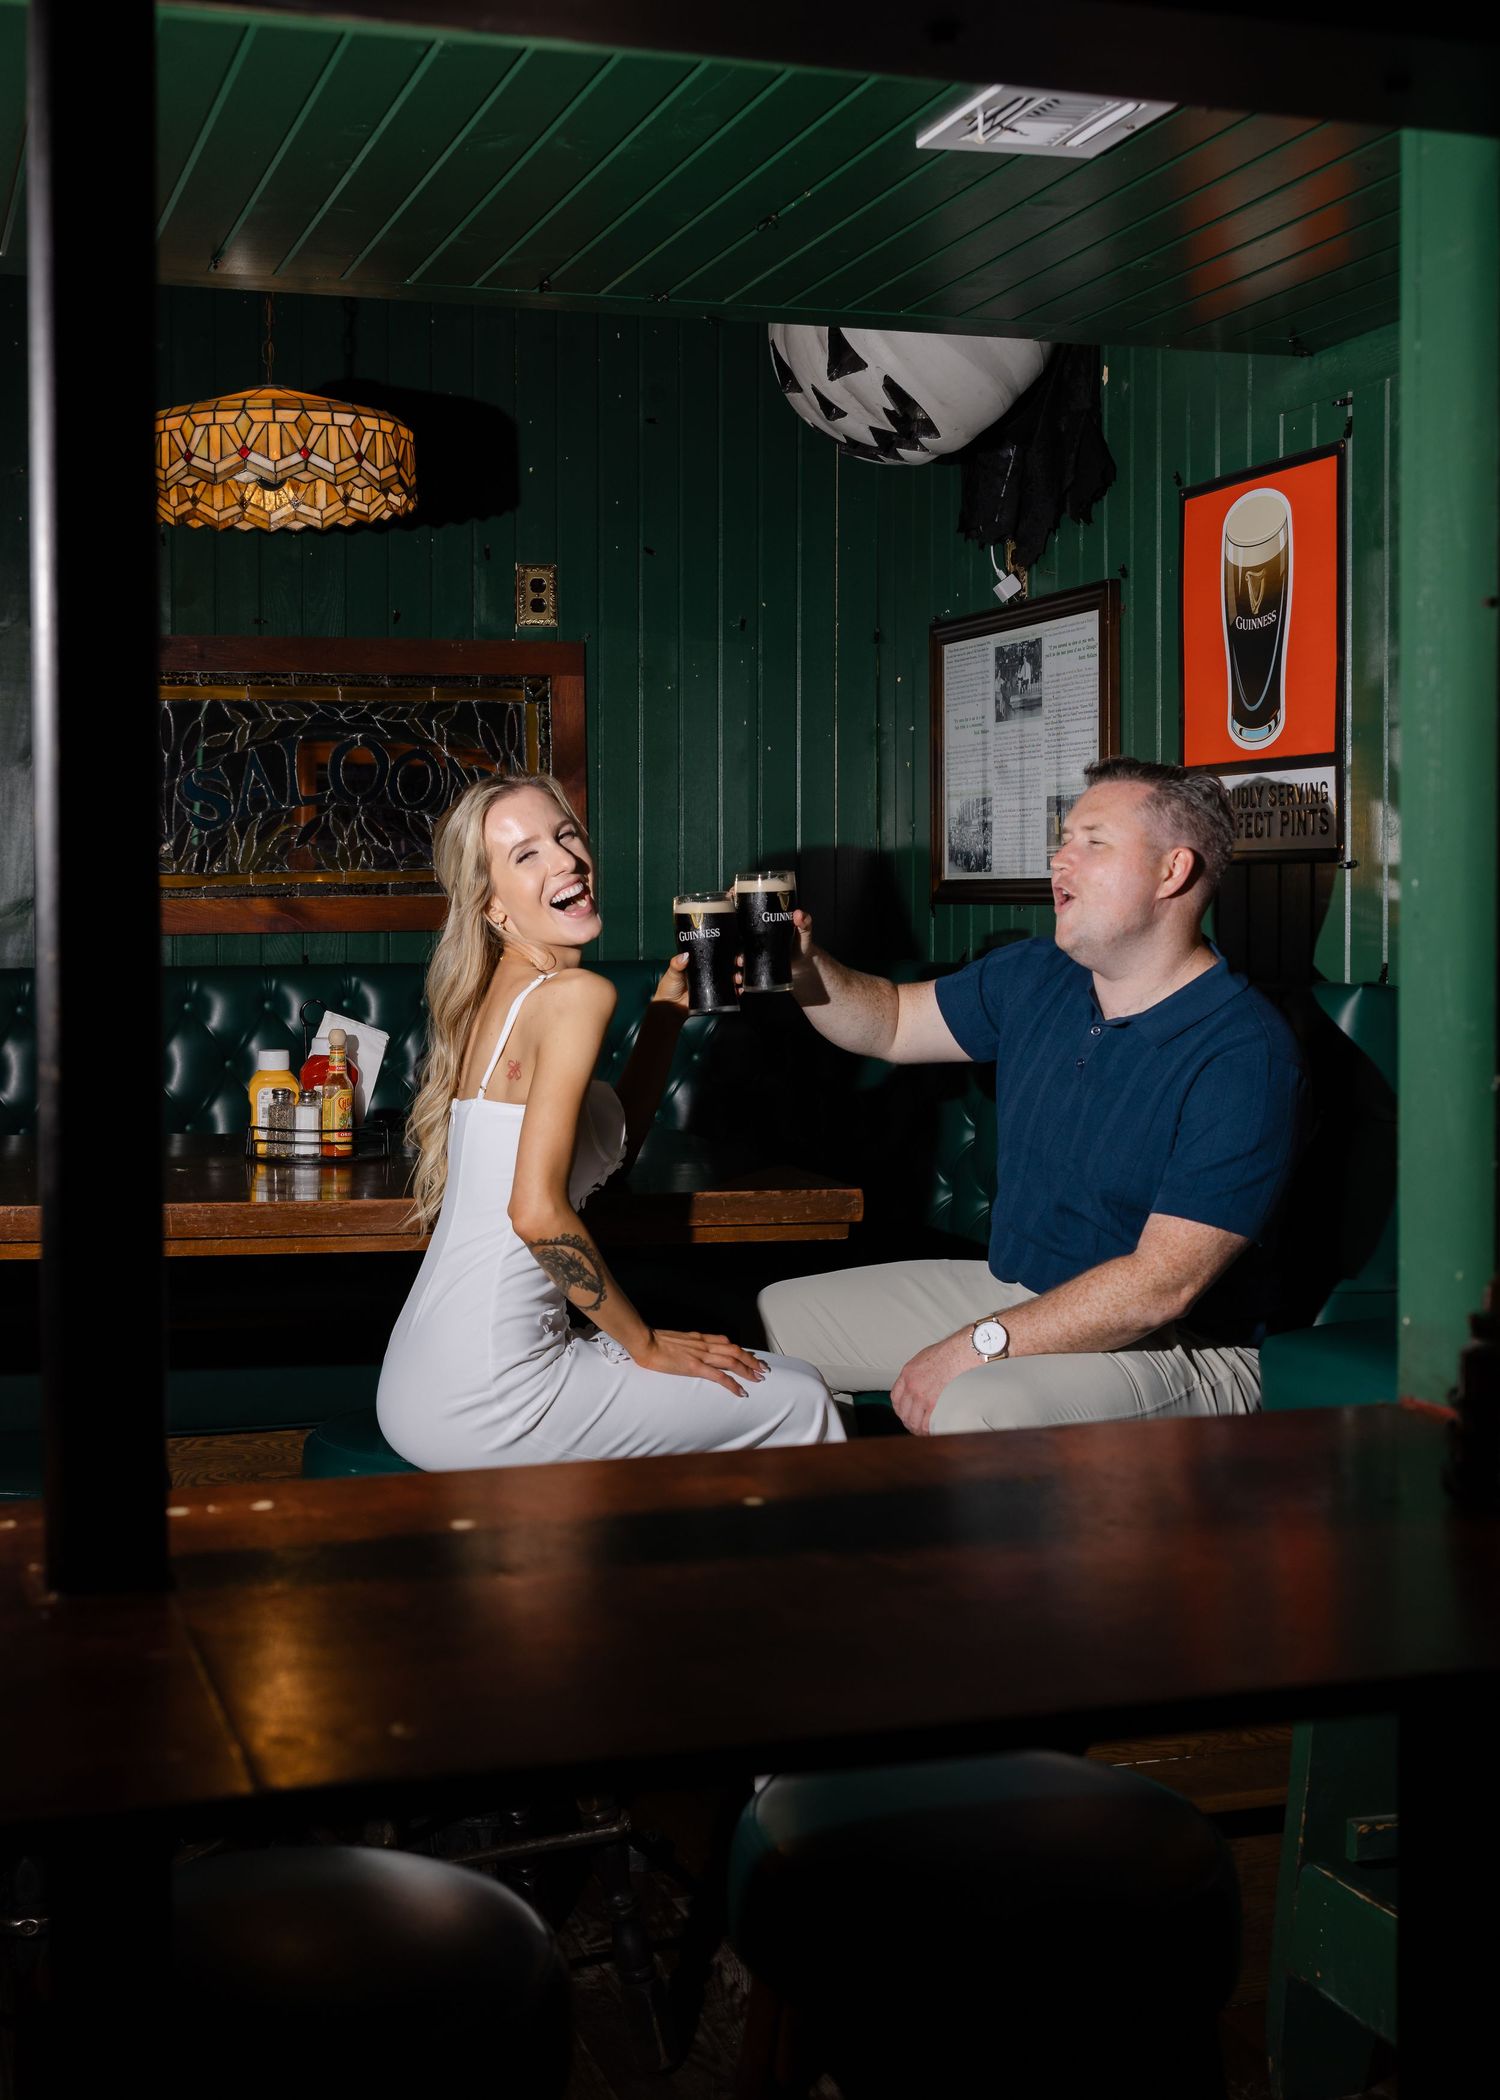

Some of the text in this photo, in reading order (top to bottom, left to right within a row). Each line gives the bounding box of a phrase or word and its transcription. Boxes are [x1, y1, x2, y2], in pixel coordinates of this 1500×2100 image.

[1235, 609, 1277, 631] GUINNESS
[176, 734, 490, 832] SALOO
[1227, 781, 1329, 809] UDLY SERVING
[1236, 808, 1329, 839] FECT PINTS
[762, 911, 793, 922] GUINNE
[679, 928, 720, 942] GUINNESS
